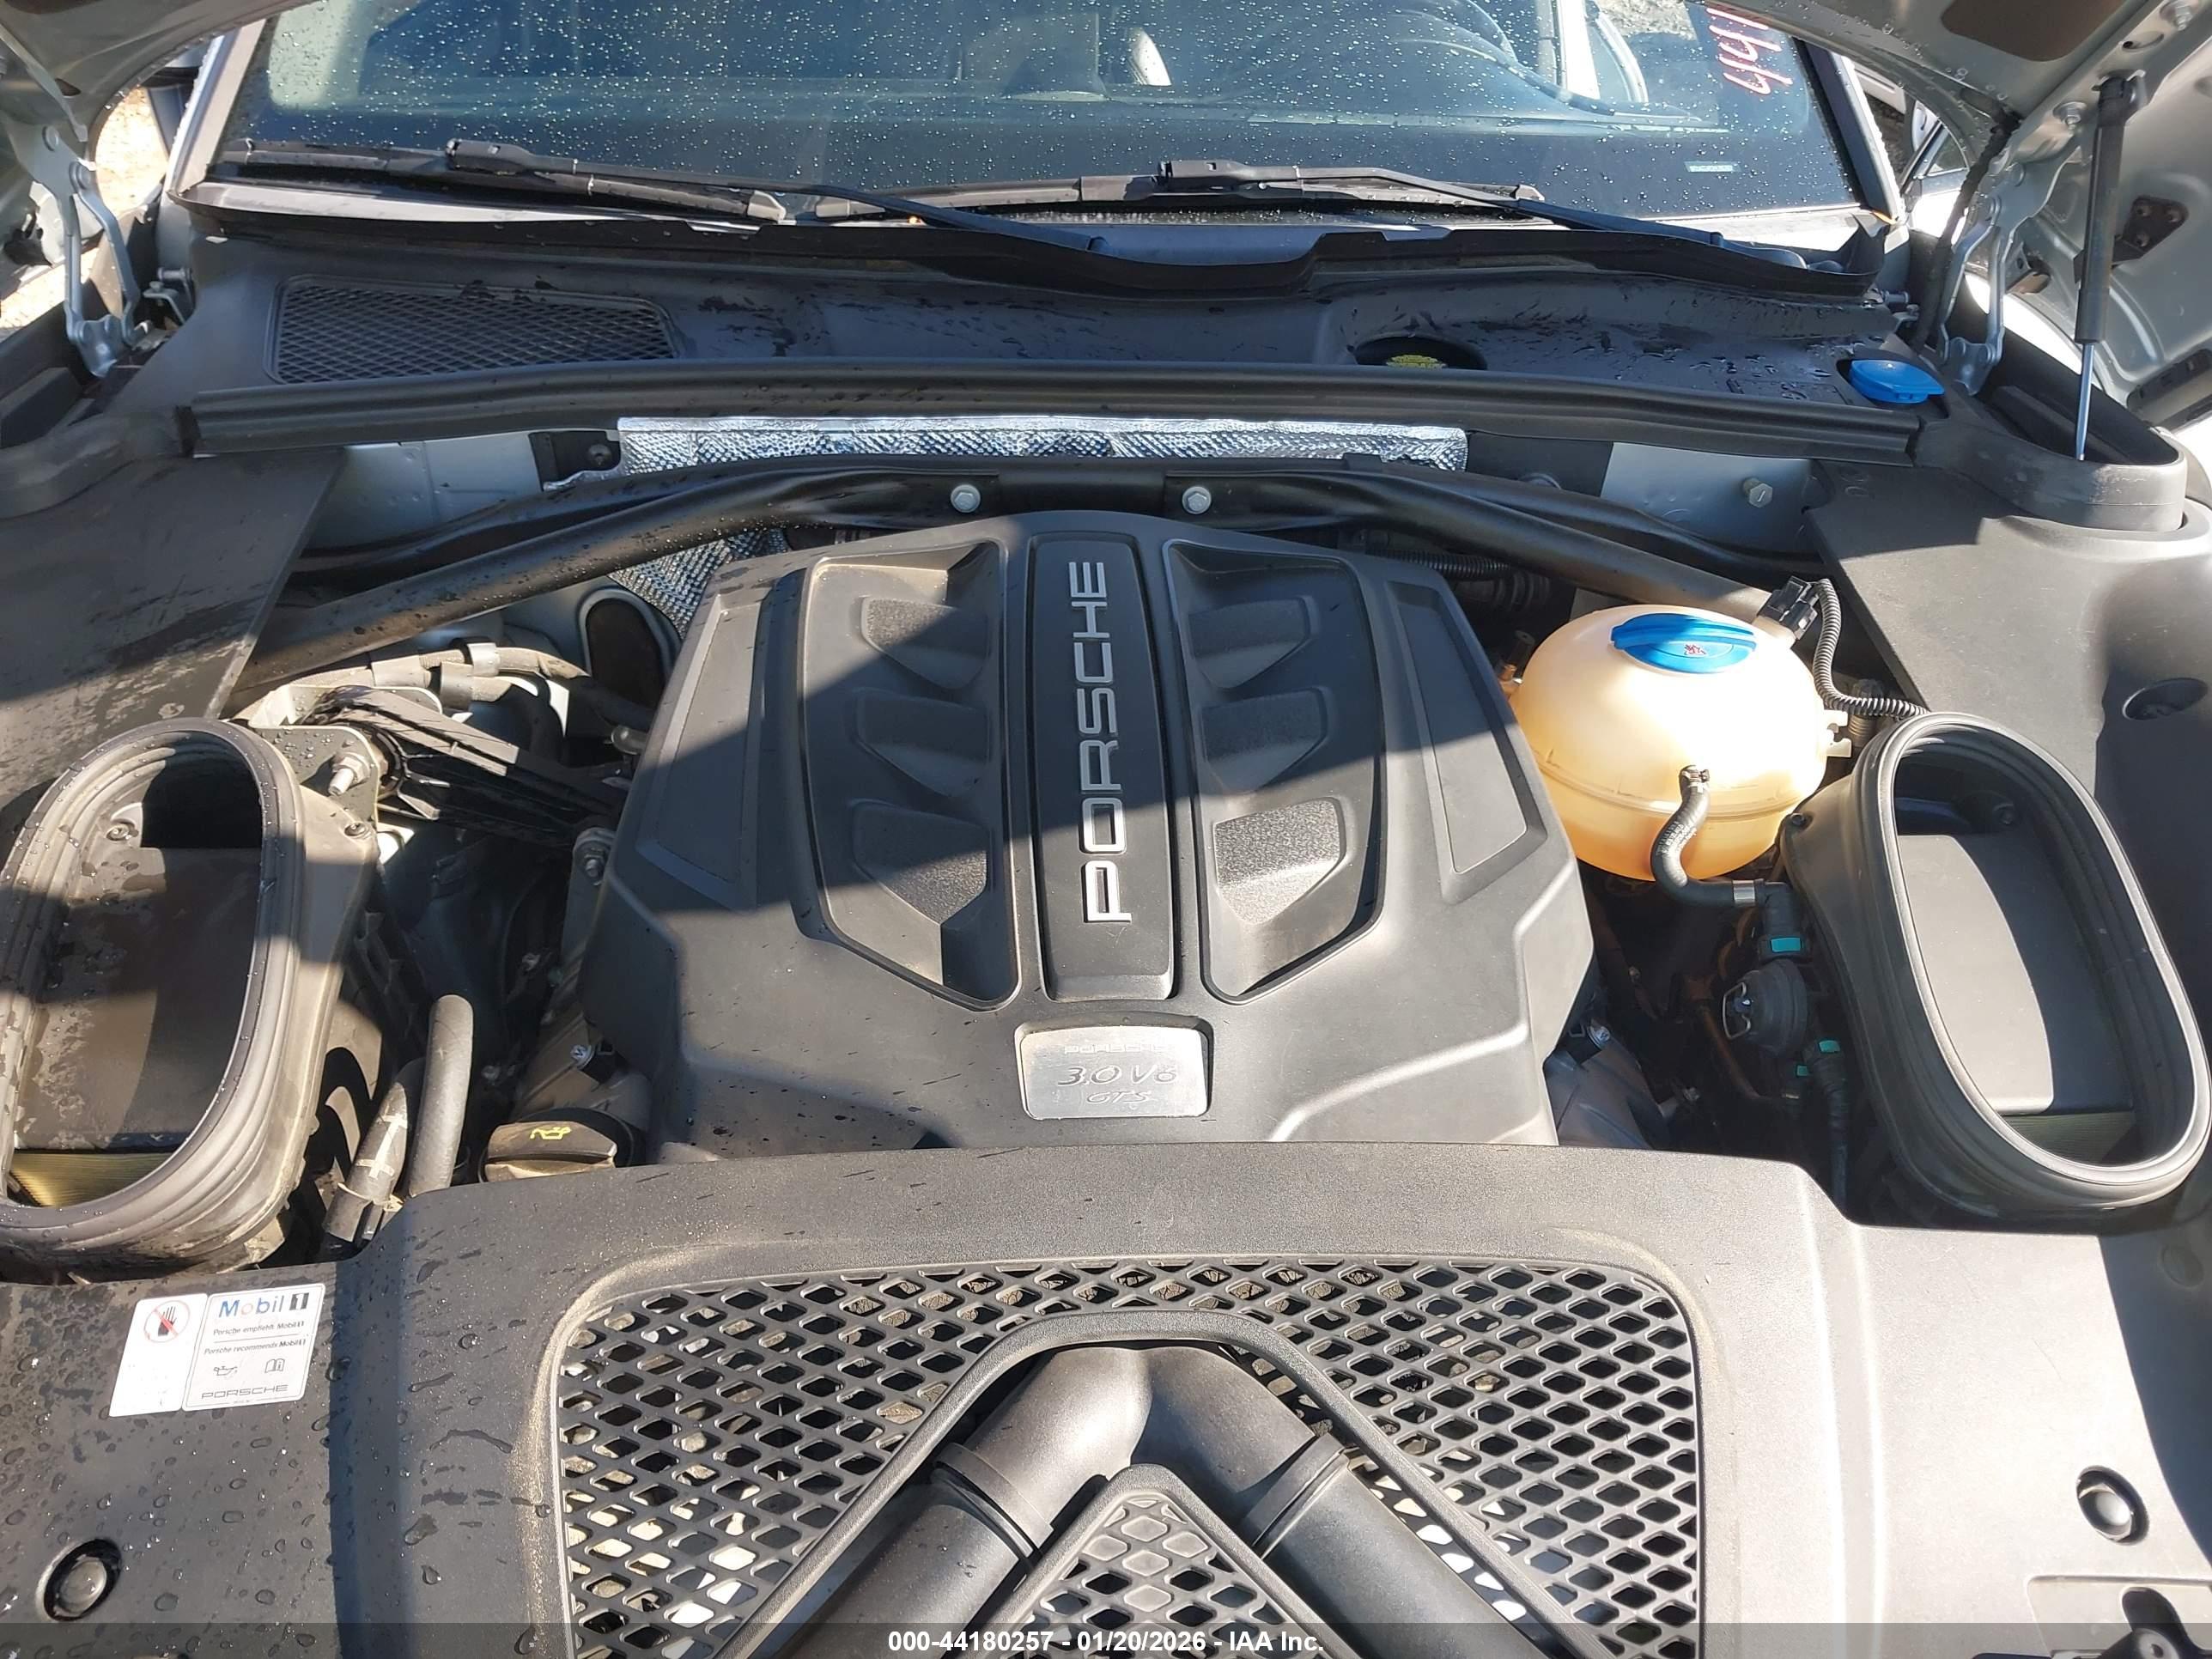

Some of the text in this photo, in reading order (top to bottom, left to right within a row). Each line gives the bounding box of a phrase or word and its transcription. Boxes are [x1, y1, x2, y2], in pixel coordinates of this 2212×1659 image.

[1069, 561, 1133, 924] PORSCHE
[1058, 1065, 1178, 1086] 3.0 V6
[1086, 1090, 1152, 1104] GTS
[218, 1295, 284, 1318] Mobil
[233, 1342, 277, 1352] recommends
[201, 1384, 289, 1400] PORSCHE
